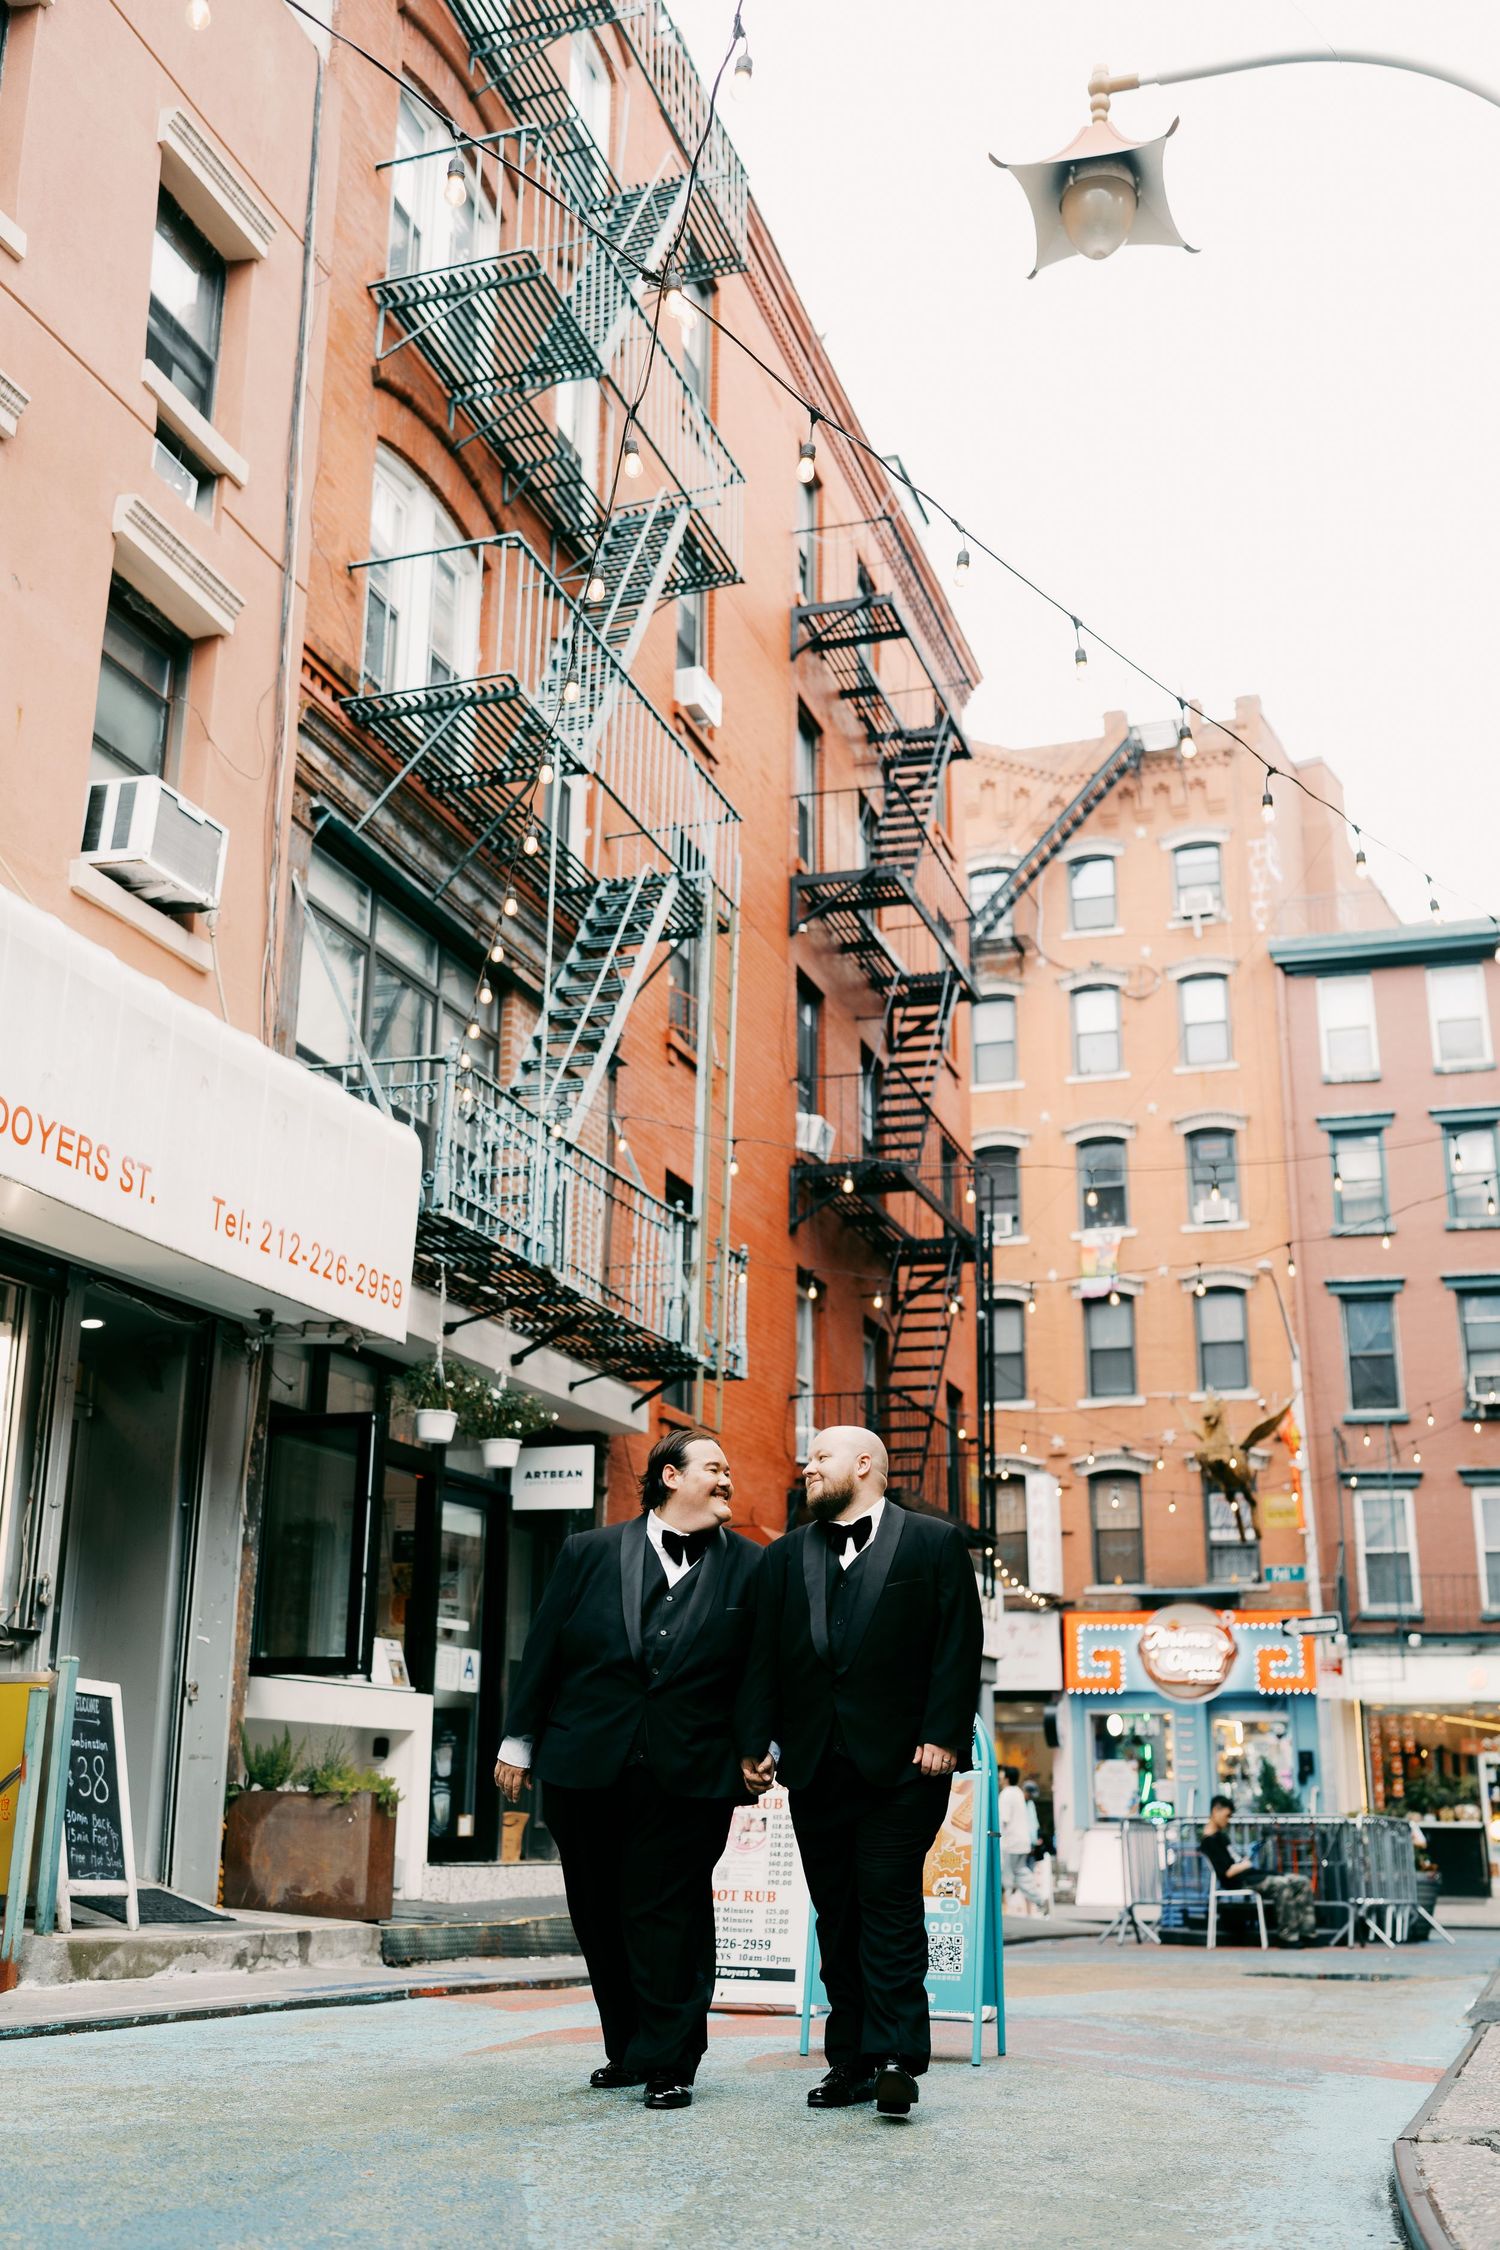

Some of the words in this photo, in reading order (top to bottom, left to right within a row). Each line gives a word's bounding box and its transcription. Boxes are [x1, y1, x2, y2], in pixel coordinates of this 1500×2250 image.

[119, 1156, 155, 1204] ST.
[212, 1196, 251, 1245] Tel:
[260, 1219, 402, 1310] 212-226-2959
[524, 1469, 583, 1479] ARTBEAN
[75, 1695, 100, 1714] ELCOME
[71, 1732, 109, 1751] ombination
[712, 1889, 739, 1901] OT
[744, 1890, 777, 1902] RUB
[722, 1916, 753, 1924] Minutes
[722, 1925, 753, 1933] Minutes
[739, 1952, 791, 1965] 10am-10pm
